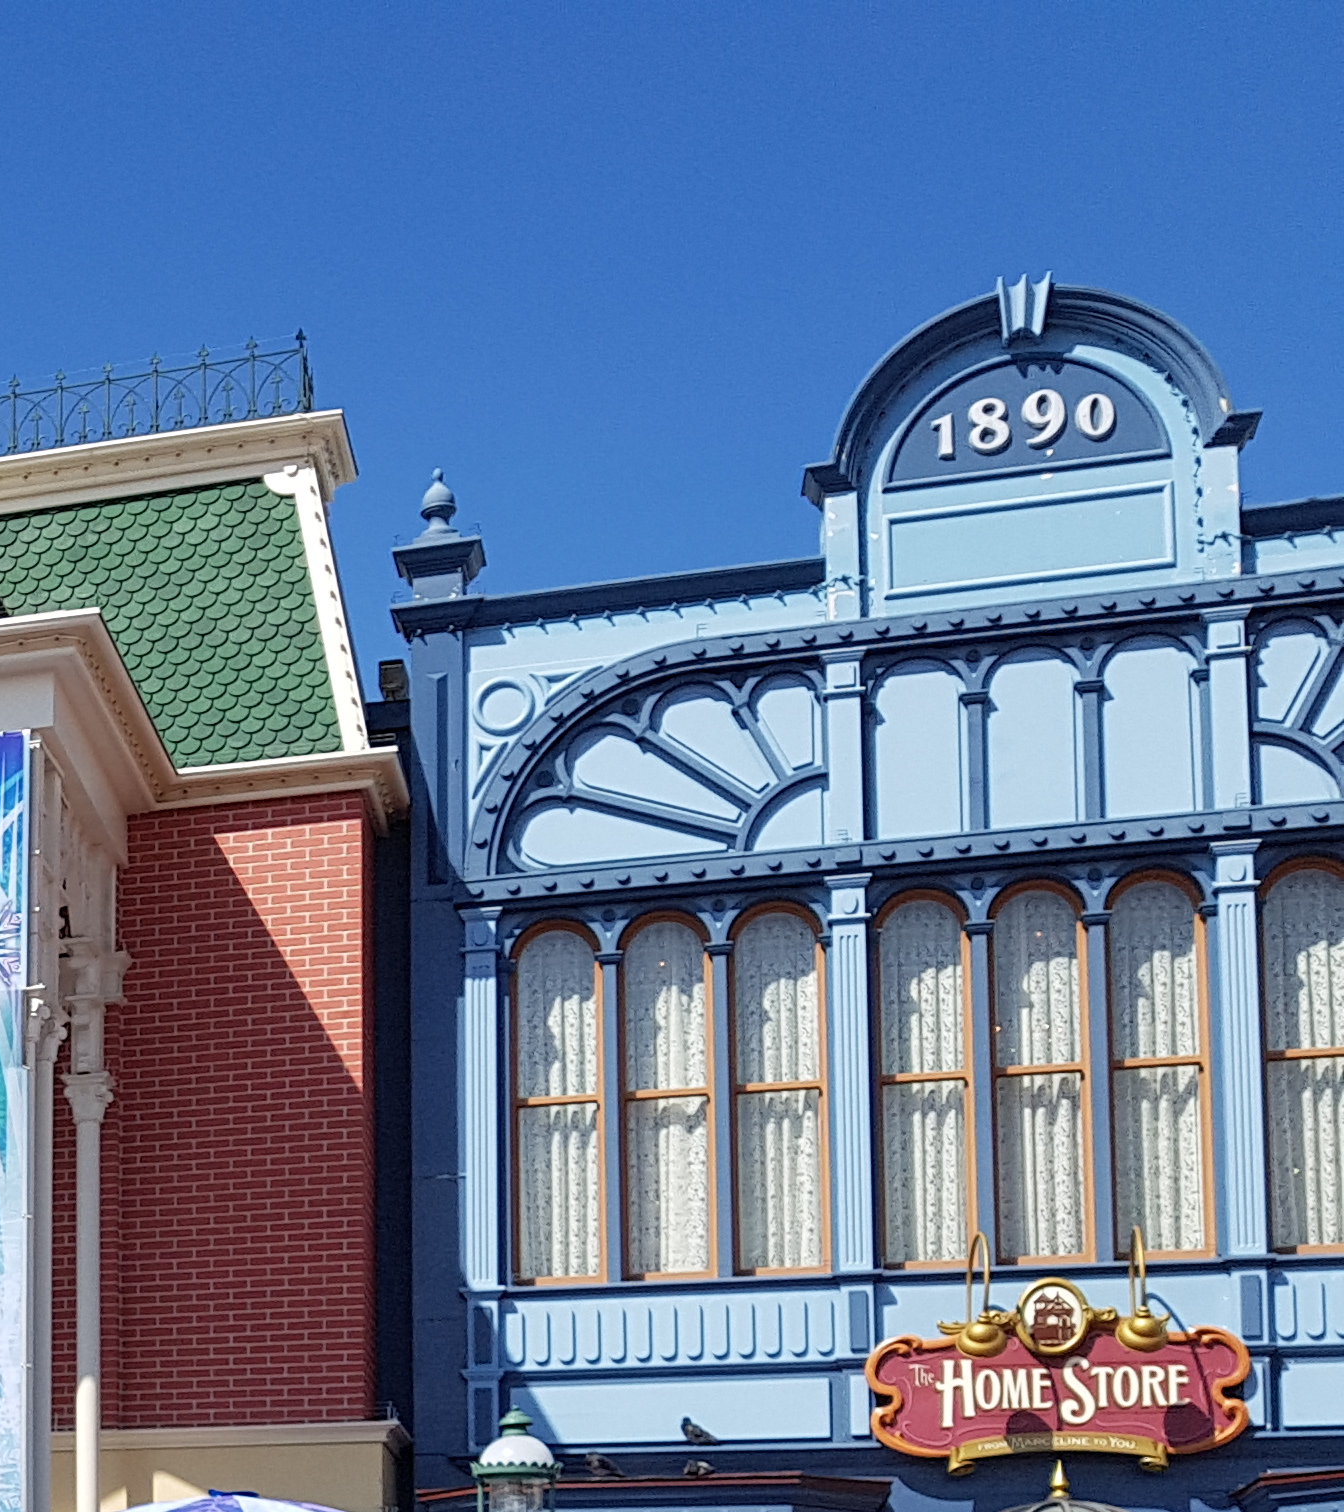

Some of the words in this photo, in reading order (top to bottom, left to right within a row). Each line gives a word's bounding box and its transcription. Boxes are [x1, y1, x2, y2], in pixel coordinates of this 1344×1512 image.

[930, 388, 1117, 462] 1890
[909, 1363, 934, 1387] The
[935, 1358, 1054, 1429] HOME
[1060, 1356, 1192, 1425] STORE
